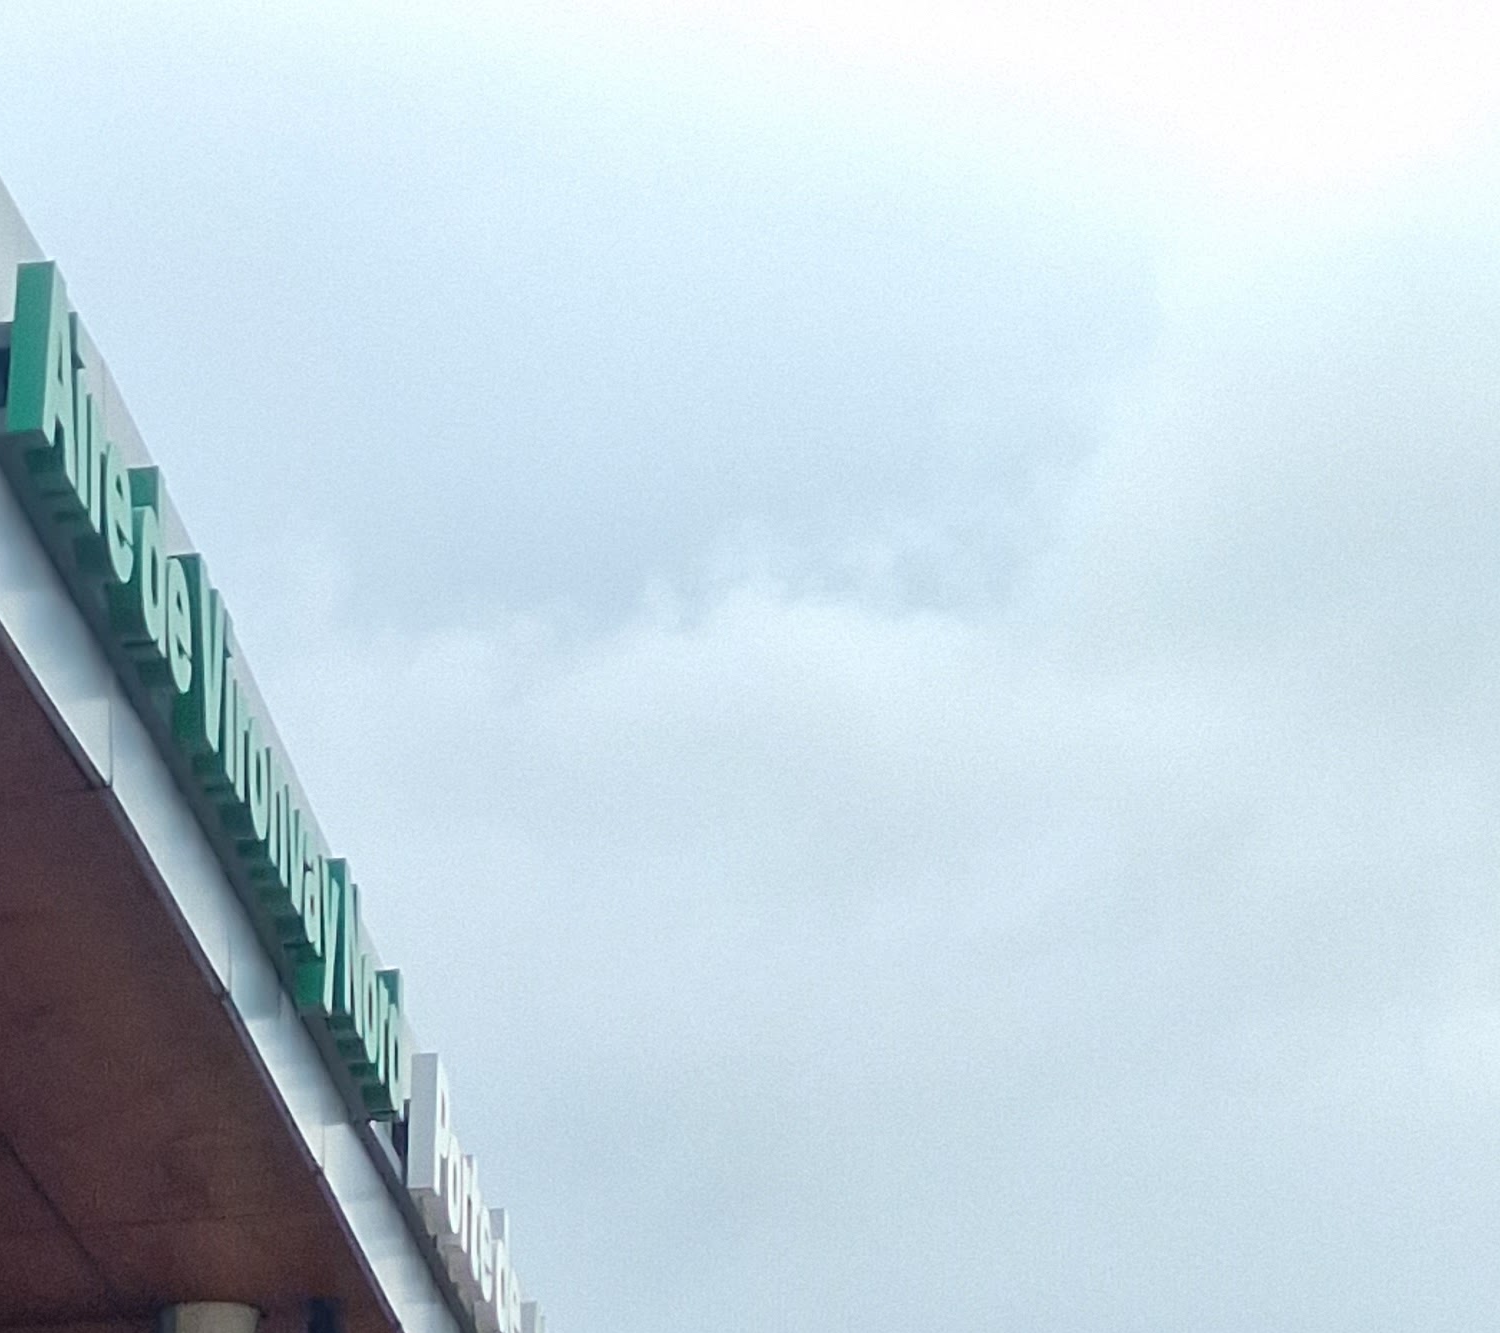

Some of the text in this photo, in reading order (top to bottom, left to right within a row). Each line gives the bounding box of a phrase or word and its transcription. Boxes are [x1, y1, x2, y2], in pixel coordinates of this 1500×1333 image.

[12, 260, 402, 1121] Aire de Vironvay Nord
[414, 1053, 493, 1303] Porte
